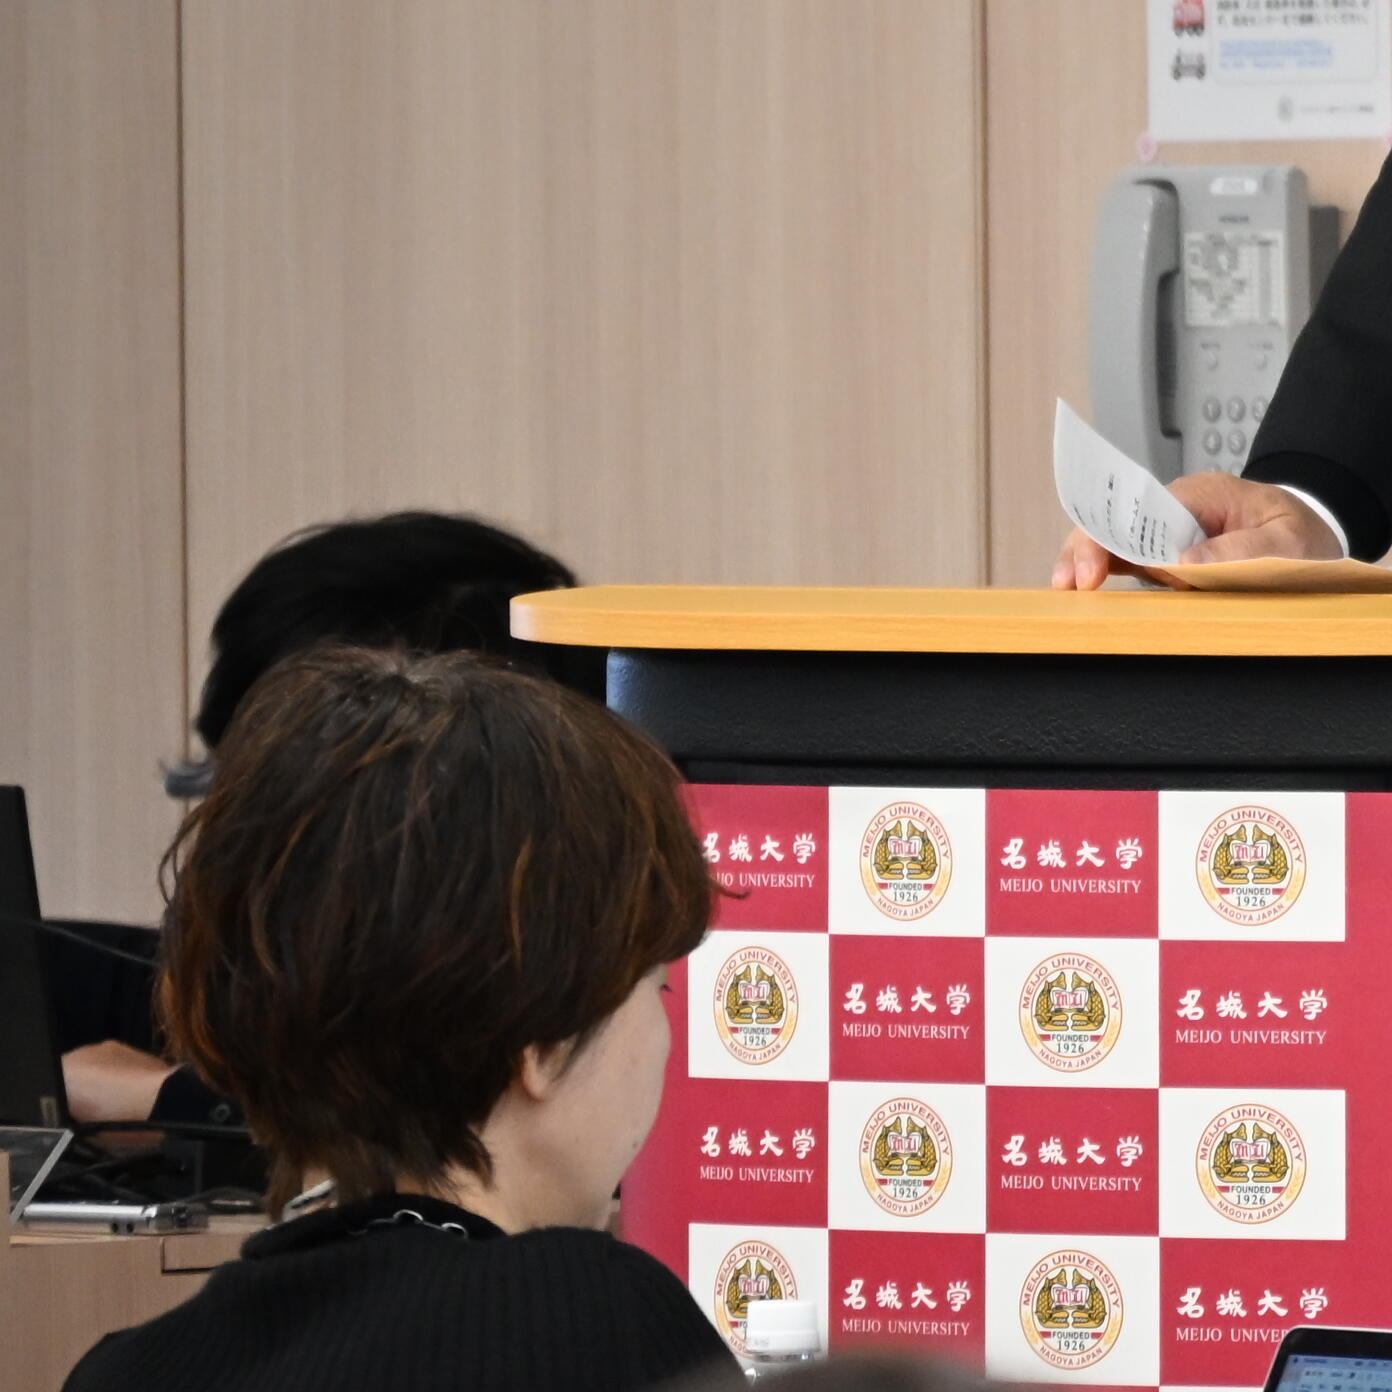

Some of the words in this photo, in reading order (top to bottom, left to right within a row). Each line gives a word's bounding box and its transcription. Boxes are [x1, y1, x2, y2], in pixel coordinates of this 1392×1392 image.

[863, 815, 886, 858] MEIJO
[889, 806, 950, 859] UNIVERSITY
[1199, 819, 1228, 863] MEIJO
[1231, 810, 1304, 863] UNIVERSITY
[703, 833, 816, 864] 名城大学
[1000, 838, 1143, 869] 名城大学
[739, 874, 815, 889] UNIVERSITY
[889, 883, 923, 891] FOUNDED
[1000, 878, 1043, 893] MEIJO
[1050, 879, 1142, 895] UNIVERSITY
[1231, 887, 1271, 895] FOUNDED
[893, 891, 919, 902] 1926
[1236, 895, 1267, 907] 1926
[877, 897, 908, 916] NAGOYA
[910, 898, 935, 916] JAPAN
[1217, 902, 1254, 922] NAGOYA
[1256, 902, 1285, 922] JAPAN
[716, 959, 738, 1002] MEIJO
[739, 951, 797, 1004] UNIVERSITY
[1022, 966, 1049, 1009] MEIJO
[1051, 957, 1120, 1010] UNIVERSITY
[843, 983, 971, 1015] 名城大学
[1177, 989, 1328, 1021] 名城大学
[739, 1027, 771, 1035] FOUNDED
[842, 1024, 881, 1038] MEIJO
[888, 1024, 970, 1040] UNIVERSITY
[1052, 1034, 1089, 1042] FOUNDED
[1175, 1029, 1222, 1044] MEIJO
[1230, 1029, 1327, 1045] UNIVERSITY
[743, 1036, 767, 1046] 1926
[1056, 1042, 1085, 1054] 1926
[729, 1041, 758, 1061] NAGOYA
[759, 1042, 782, 1061] JAPAN
[1038, 1048, 1073, 1068] NAGOYA
[1075, 1049, 1103, 1068] JAPAN
[862, 1110, 886, 1154] MEIJO
[888, 1102, 950, 1156] UNIVERSITY
[1199, 1117, 1228, 1161] MEIJO
[1230, 1108, 1304, 1162] UNIVERSITY
[700, 1126, 815, 1159] 名城大学
[1001, 1135, 1144, 1167] 名城大学
[699, 1165, 734, 1180] MEIJO
[738, 1166, 815, 1184] UNIVERSITY
[888, 1178, 923, 1187] FOUNDED
[1001, 1174, 1044, 1190] MEIJO
[1051, 1175, 1143, 1192] UNIVERSITY
[893, 1187, 919, 1198] 1926
[1230, 1185, 1271, 1194] FOUNDED
[876, 1193, 908, 1213] NAGOYA
[910, 1194, 935, 1213] JAPAN
[1236, 1194, 1267, 1206] 1926
[1216, 1200, 1254, 1220] NAGOYA
[1256, 1201, 1285, 1220] JAPAN
[716, 1253, 738, 1296] MEIJO
[739, 1245, 797, 1298] UNIVERSITY
[1023, 1263, 1050, 1305] MEIJO
[1052, 1254, 1121, 1308] UNIVERSITY
[843, 1279, 971, 1311] 名城大学
[1177, 1287, 1328, 1319] 名城大学
[842, 1318, 881, 1333] MEIJO
[888, 1319, 970, 1336] UNIVERSITY
[1052, 1331, 1090, 1340] FOUNDED
[1176, 1327, 1222, 1342] MEIJO
[1230, 1328, 1289, 1343] UNIVER
[1057, 1340, 1086, 1351] 1926
[1039, 1345, 1074, 1366] NAGOYA
[1076, 1348, 1103, 1365] JAPAN
